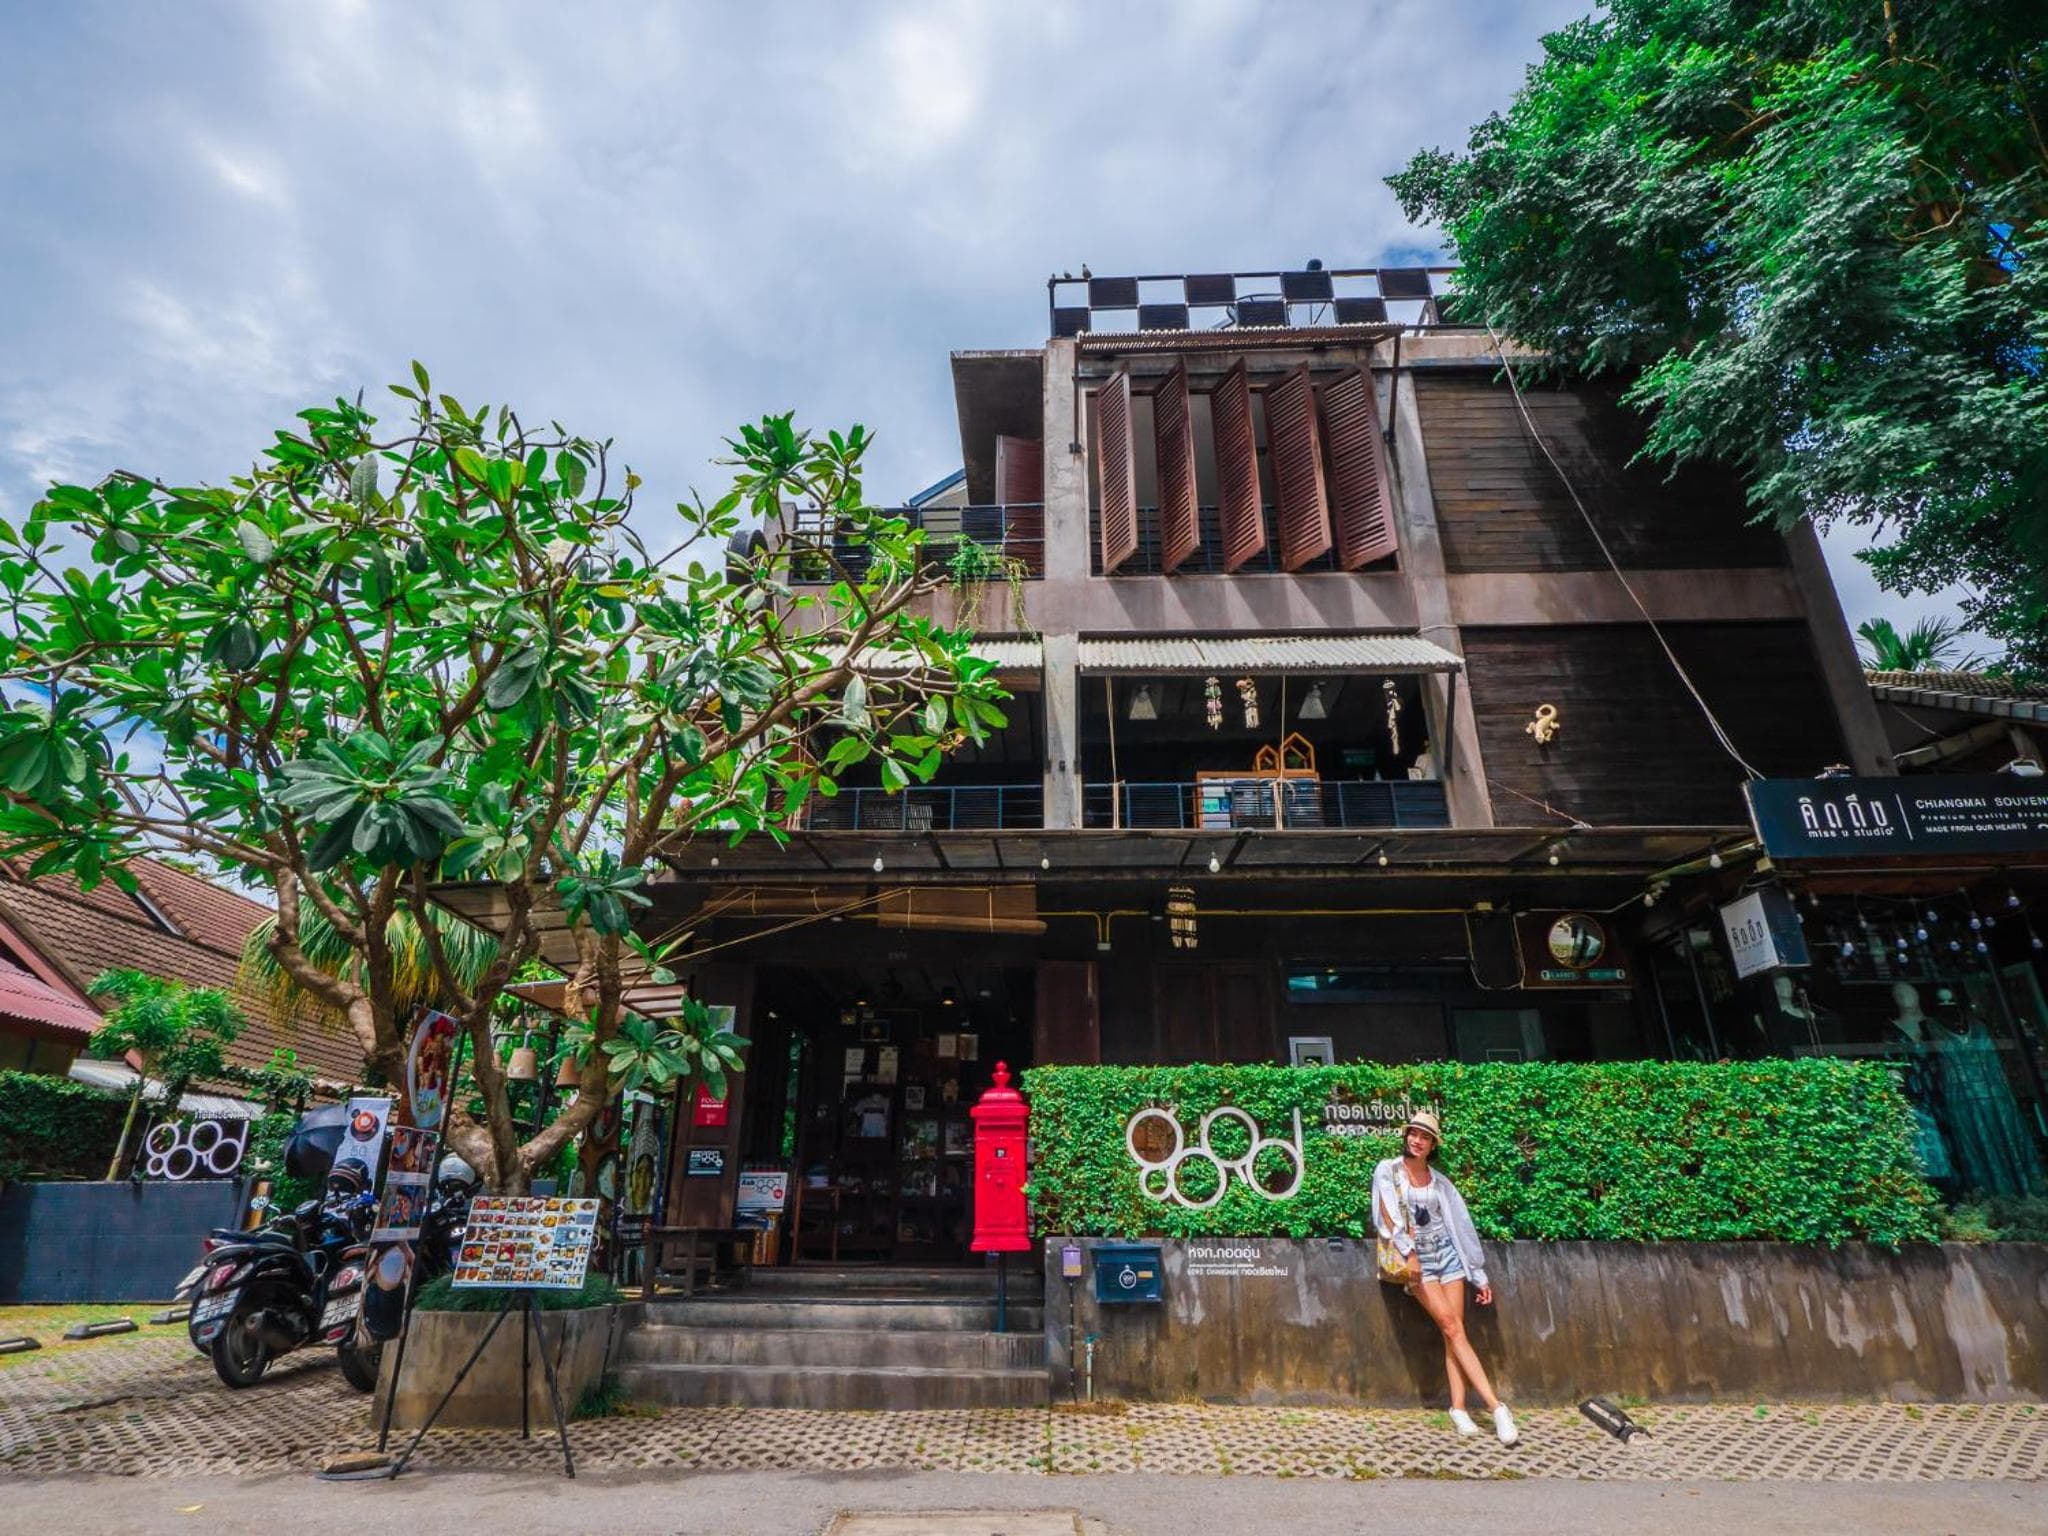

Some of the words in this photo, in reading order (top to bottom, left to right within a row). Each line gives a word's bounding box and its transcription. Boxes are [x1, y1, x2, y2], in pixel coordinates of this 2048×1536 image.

[1915, 798, 1986, 809] CHIANGMAI
[1808, 829, 1838, 838] miss
[1853, 827, 1892, 837] studio
[1926, 824, 1949, 833] MADE
[1950, 824, 1974, 832] FROM
[1975, 824, 1994, 832] OUR
[1995, 822, 2028, 831] HEARTS
